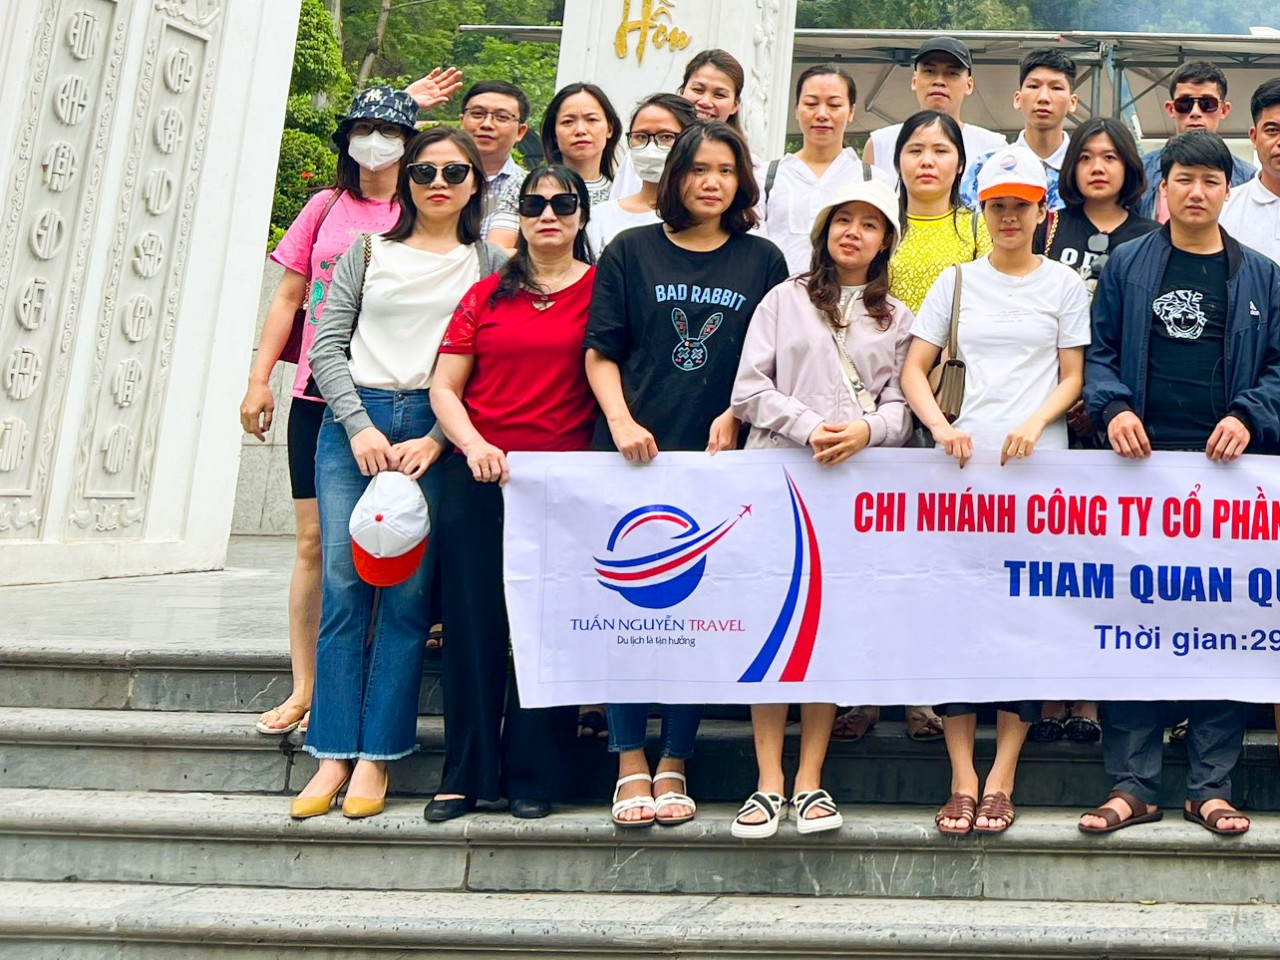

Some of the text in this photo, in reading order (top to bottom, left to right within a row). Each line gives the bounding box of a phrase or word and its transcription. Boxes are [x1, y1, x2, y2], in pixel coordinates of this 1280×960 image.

[655, 283, 747, 312] BAD RABBIT
[855, 492, 906, 532] CHI
[917, 488, 1015, 533] NHÁNH
[1027, 488, 1107, 536] CÔNG
[1118, 497, 1152, 536] TY
[1163, 484, 1201, 538] CỔ
[1004, 561, 1113, 598] THAM
[1130, 565, 1231, 603] QUAN
[688, 619, 746, 632] TRAVEL
[1094, 625, 1160, 649] Thời
[617, 635, 629, 645] Du
[630, 636, 645, 647] lịch
